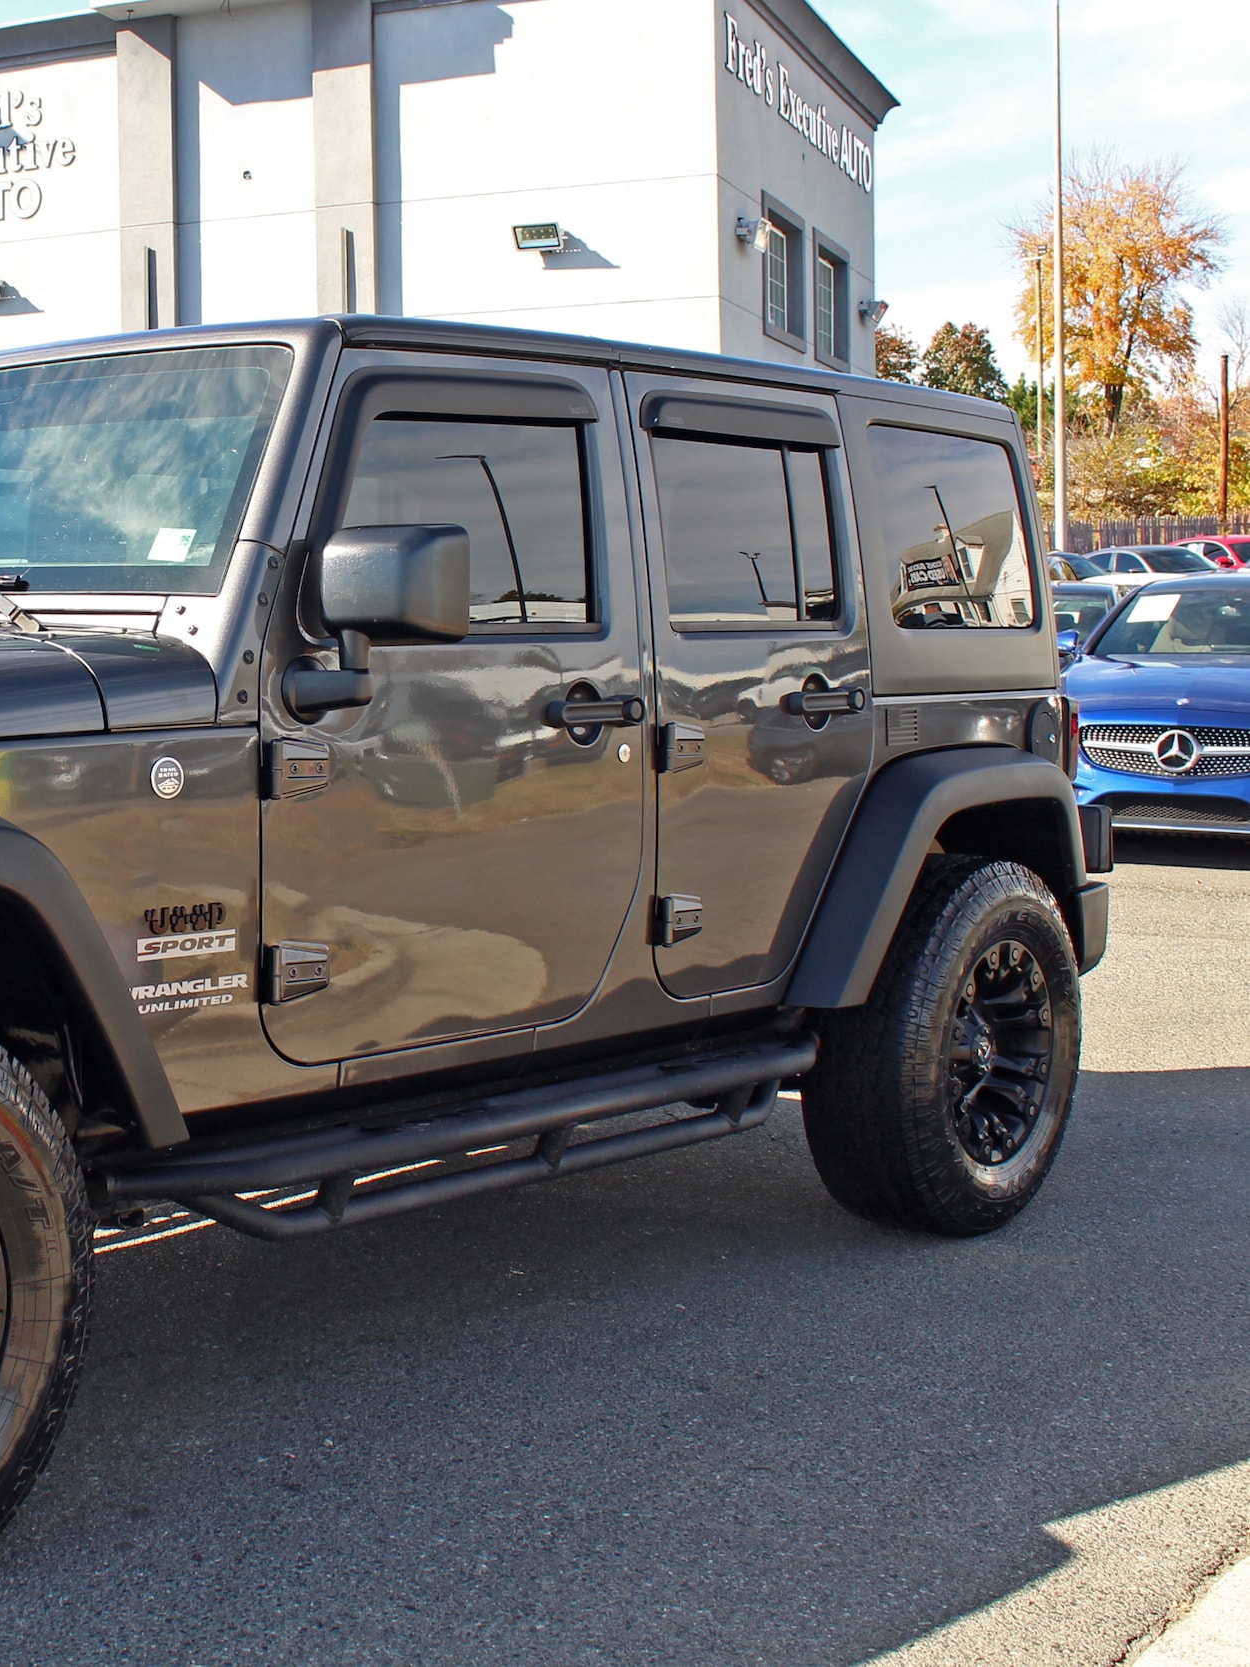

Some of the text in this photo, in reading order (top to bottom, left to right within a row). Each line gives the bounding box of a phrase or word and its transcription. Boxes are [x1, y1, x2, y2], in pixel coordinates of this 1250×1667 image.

[724, 11, 873, 193] Fred's Executive AUTO
[138, 934, 235, 957] SPORT
[137, 994, 233, 1015] UNLIMITED
